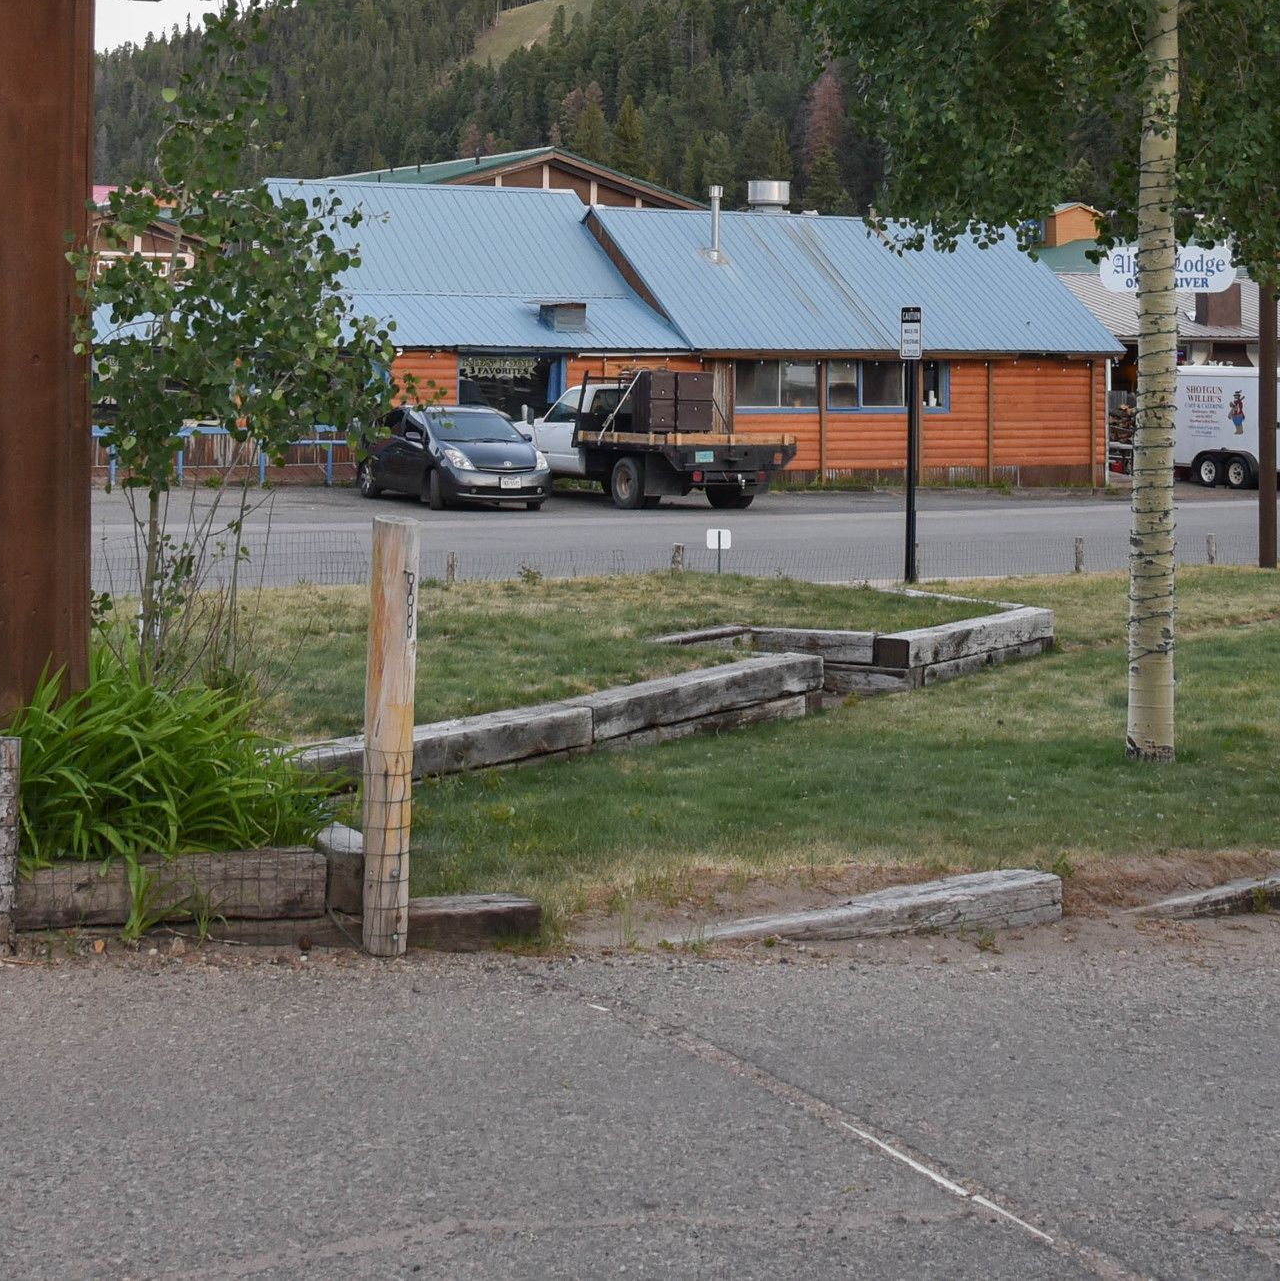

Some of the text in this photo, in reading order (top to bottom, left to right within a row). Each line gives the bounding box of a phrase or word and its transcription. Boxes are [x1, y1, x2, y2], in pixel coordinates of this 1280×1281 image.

[477, 367, 530, 375] FAVORITES
[1185, 385, 1223, 394] SHOTGUN
[1187, 394, 1222, 403] WILLIE'S
